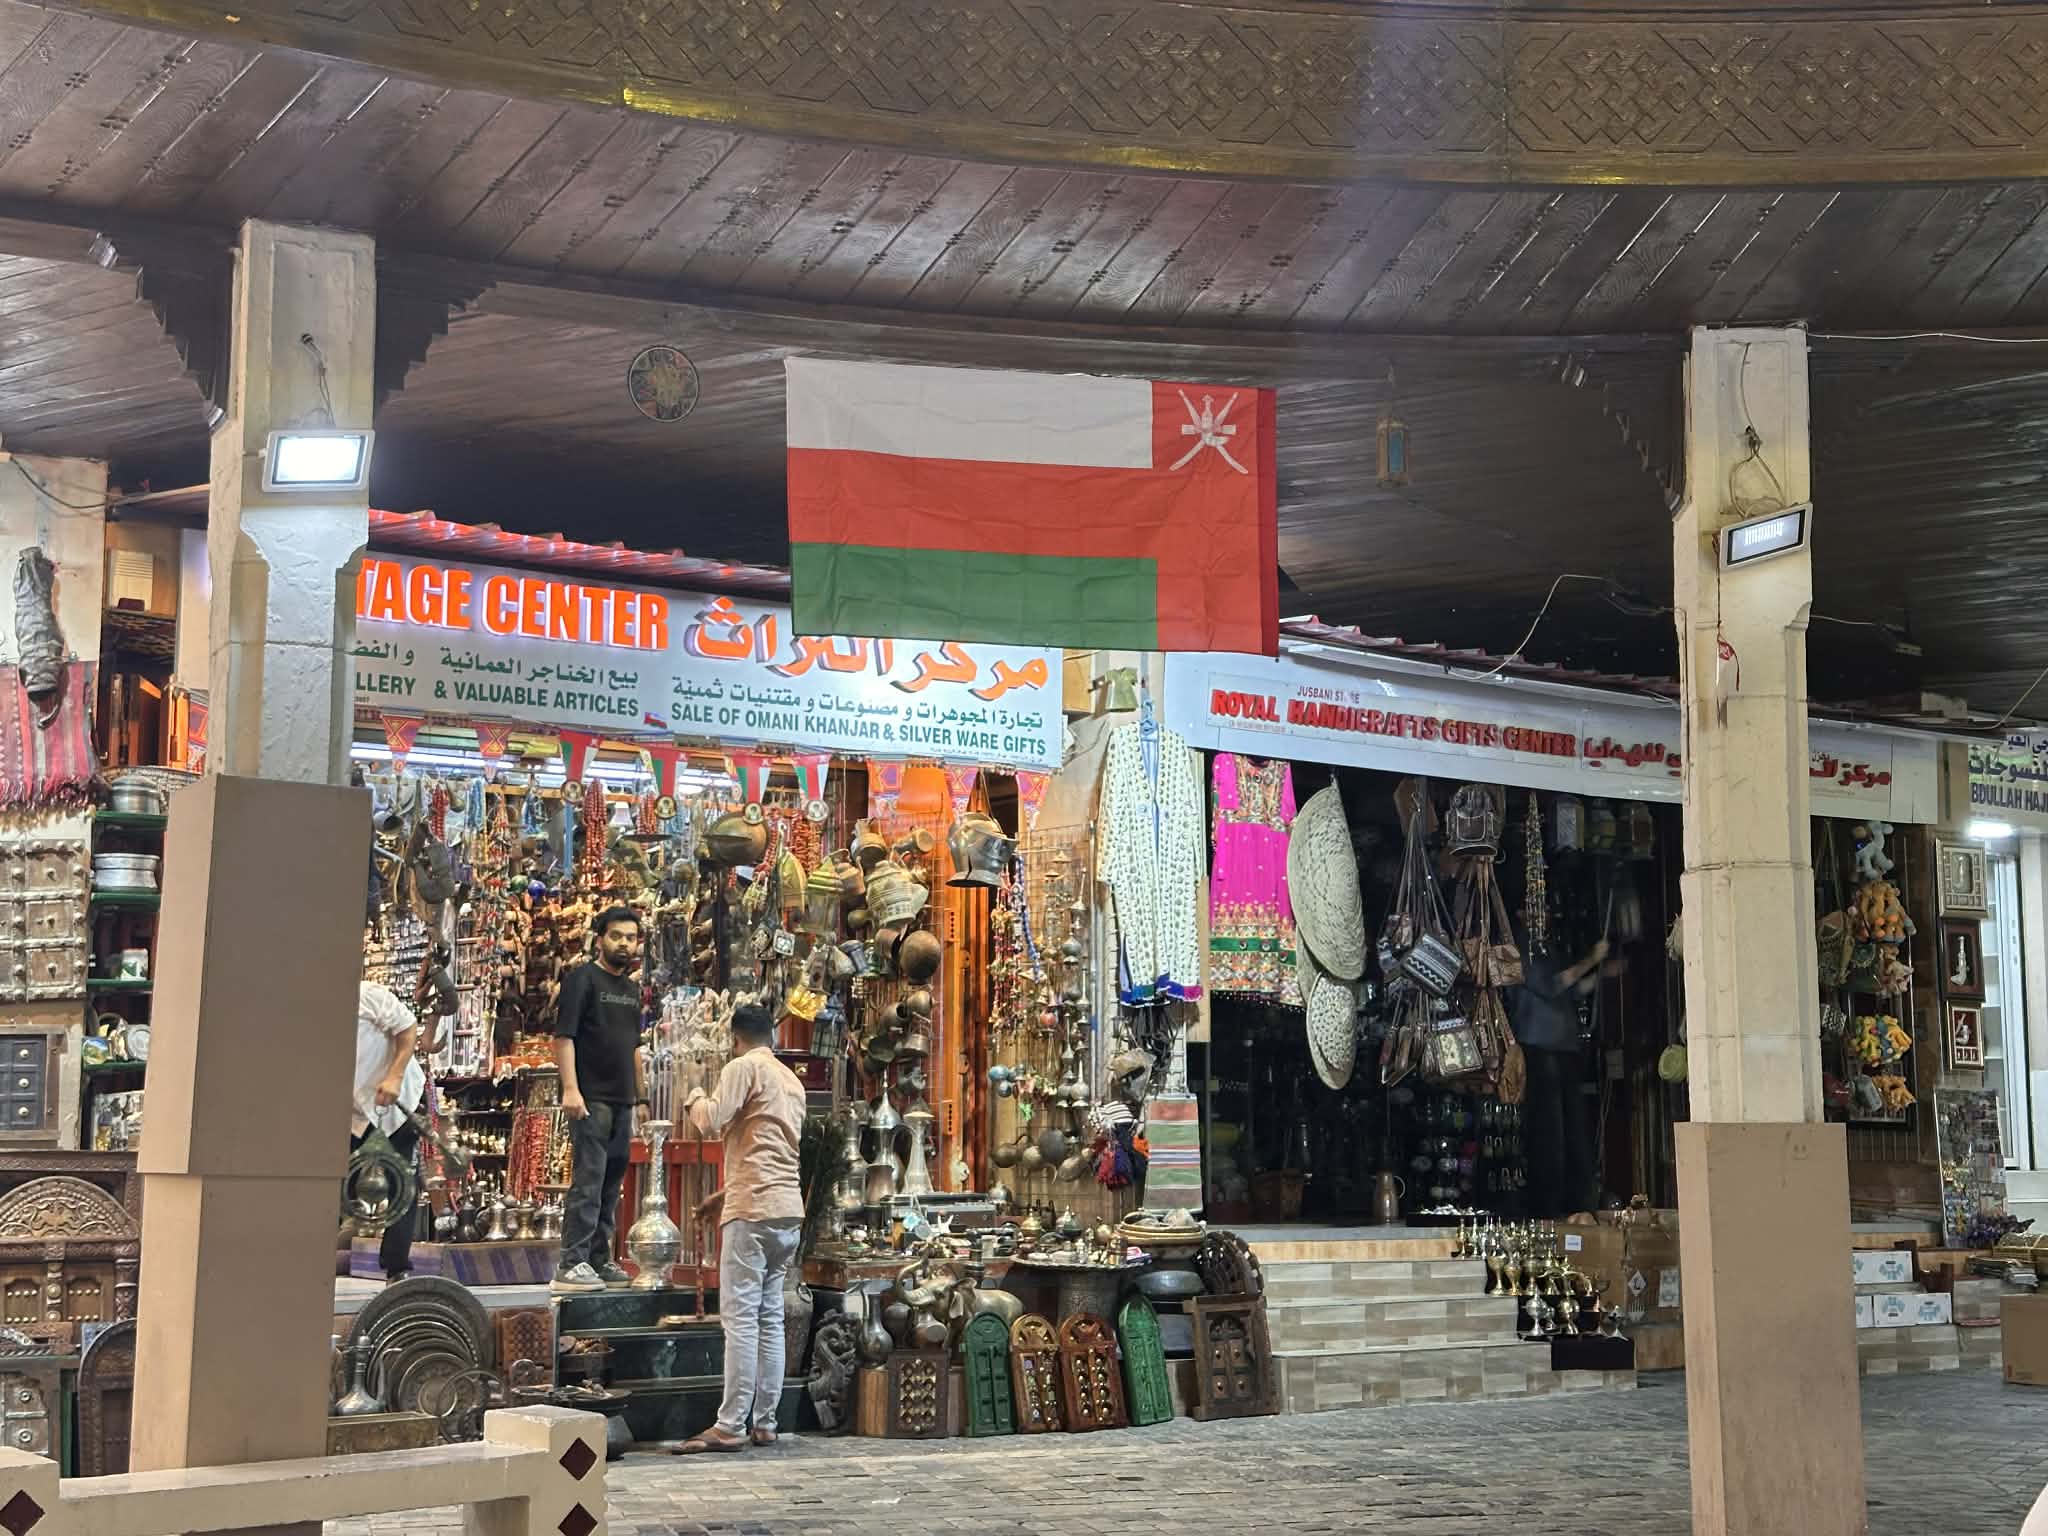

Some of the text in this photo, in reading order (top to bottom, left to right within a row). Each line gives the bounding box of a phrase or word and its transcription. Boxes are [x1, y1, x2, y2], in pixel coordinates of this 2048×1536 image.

[482, 574, 668, 651] CENTER
[441, 646, 521, 675] العمانية
[526, 663, 603, 683] الخناجر
[608, 669, 639, 690] بيع
[672, 676, 724, 700] ثمينة
[434, 680, 448, 699] &
[454, 682, 548, 706] VALUABLE
[553, 690, 639, 717] ARTICLES
[917, 702, 996, 727] المجوهرات
[1000, 710, 1043, 732] تجارة
[1211, 689, 1280, 722] ROYAL
[1287, 699, 1440, 741] HANDICRAFTS
[1442, 718, 1499, 747] GIFTS
[1502, 726, 1576, 757] CENTER
[672, 702, 713, 723] SALE
[719, 707, 741, 725] OF
[746, 710, 799, 731] OMANI
[805, 715, 879, 740] KHANJAR
[883, 723, 896, 741] &
[900, 725, 951, 746] SILVER
[957, 730, 999, 750] WARE
[1004, 735, 1046, 756] GIFTS
[1838, 763, 1892, 788] مركز
